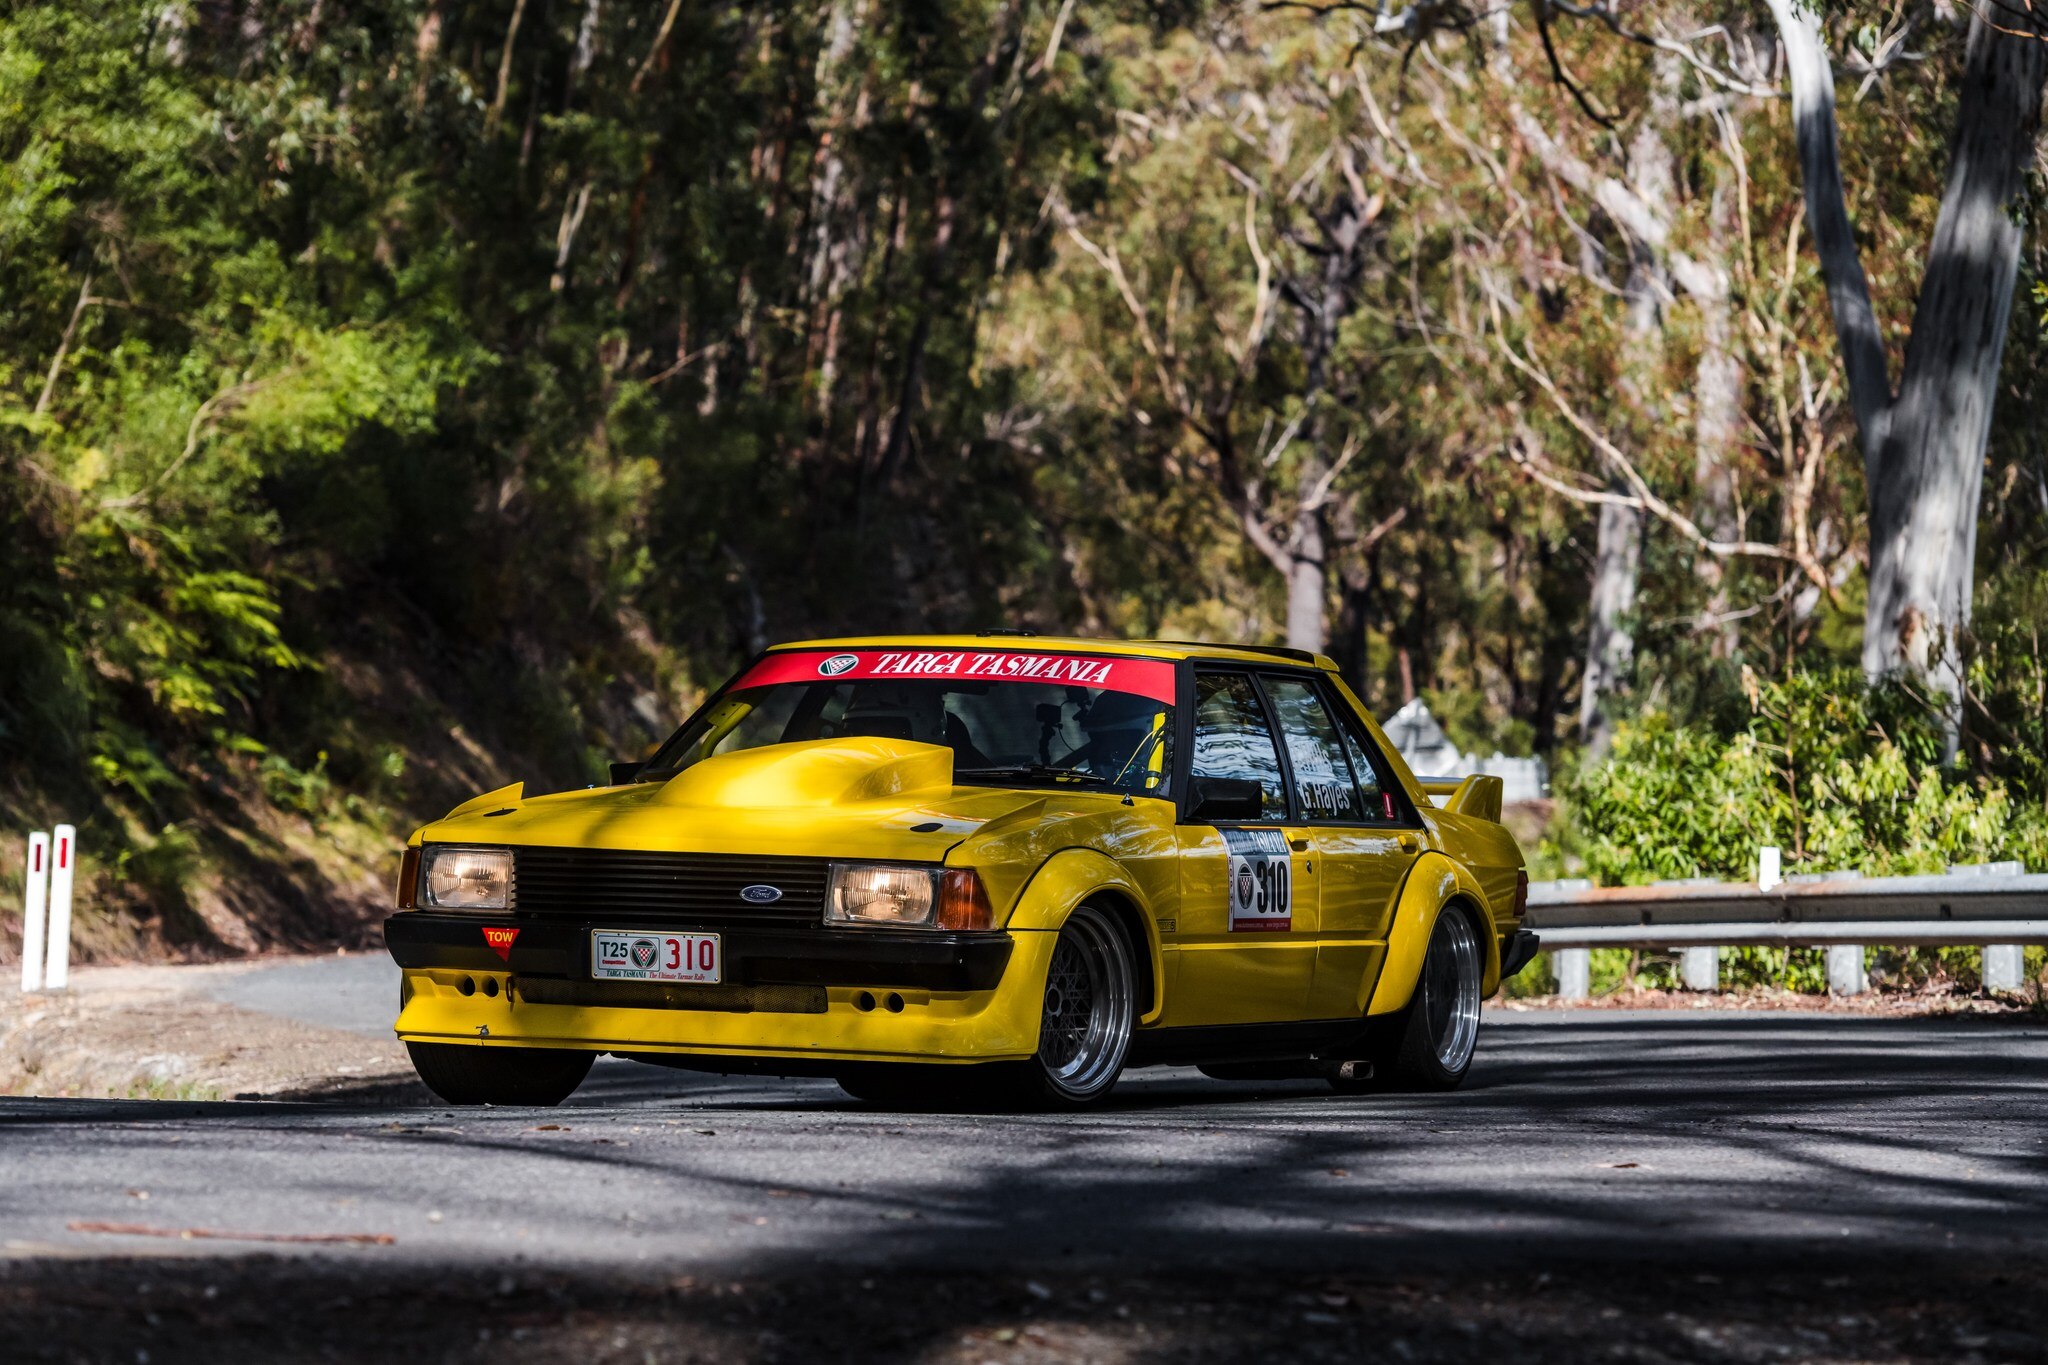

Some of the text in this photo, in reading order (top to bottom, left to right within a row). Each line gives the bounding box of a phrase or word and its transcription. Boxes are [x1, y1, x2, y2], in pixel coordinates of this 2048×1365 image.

[869, 653, 1114, 684] TARGA TASMANIA
[1299, 779, 1351, 817] G.Hayes
[1256, 860, 1288, 914] 310
[488, 931, 514, 942] TOW
[600, 942, 628, 957] T25
[665, 938, 714, 971] 310
[606, 969, 622, 977] TARGA
[623, 970, 647, 978] TASMANIA
[649, 971, 657, 979] The
[694, 974, 706, 982] Rally
